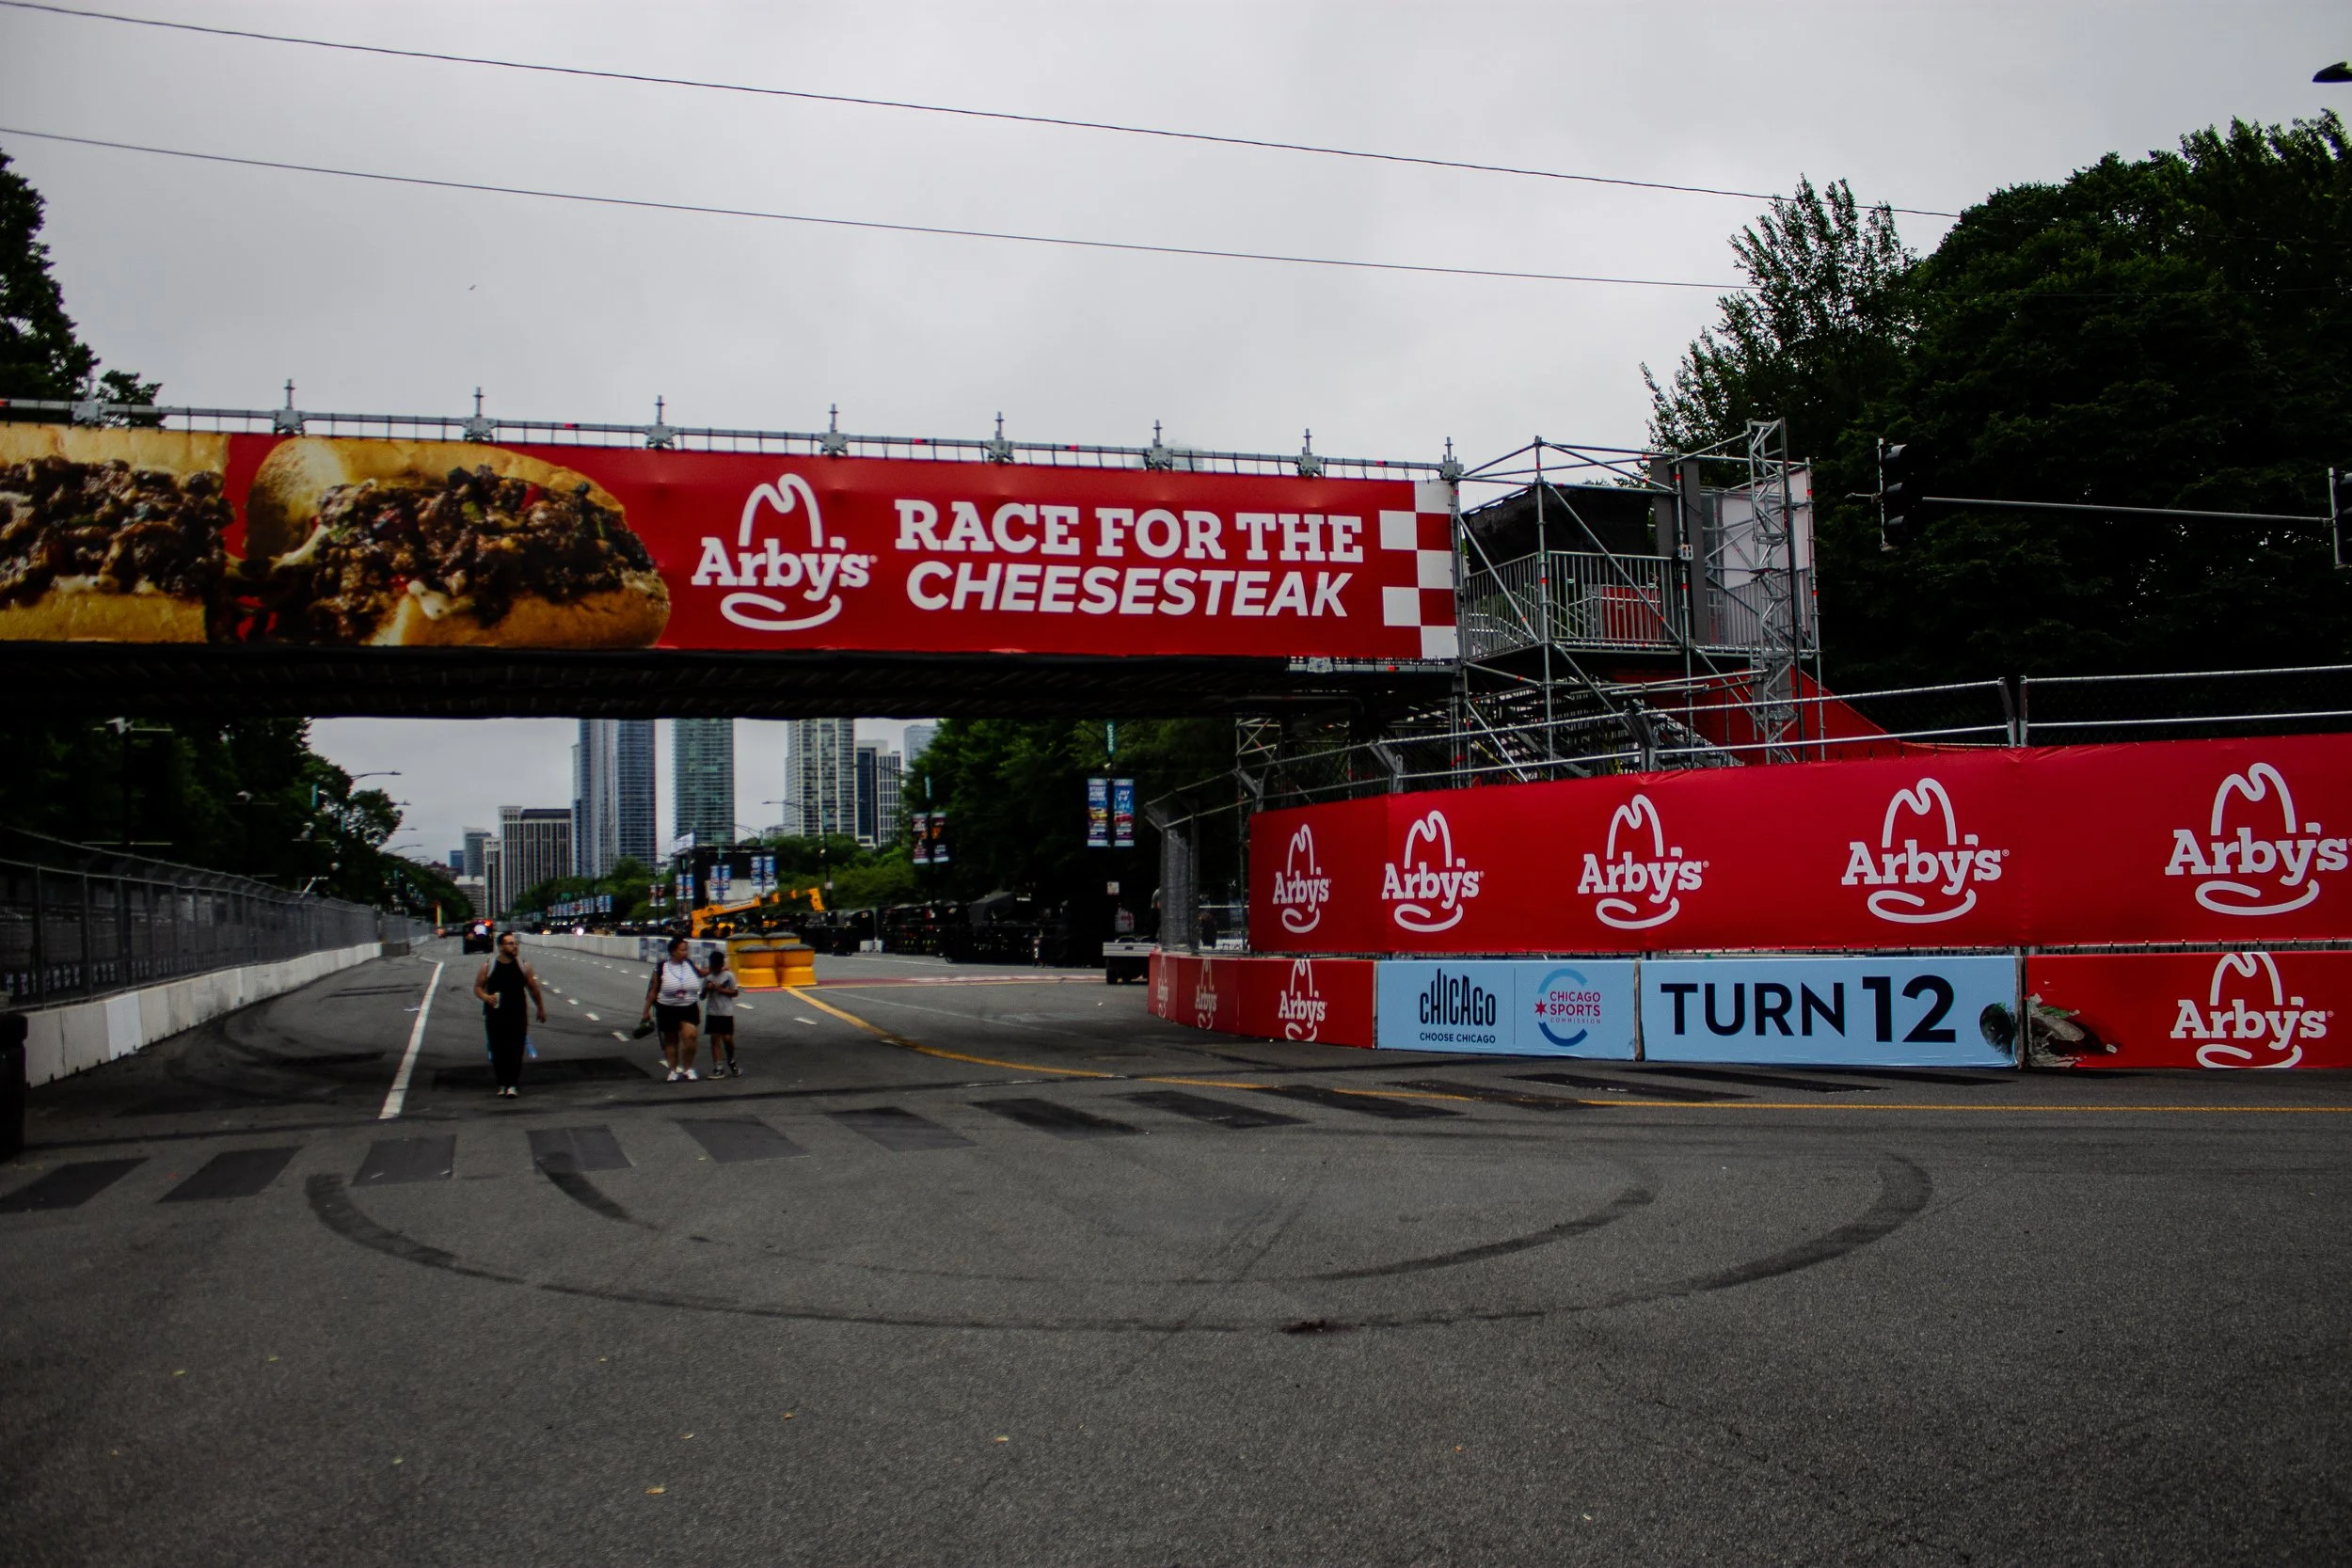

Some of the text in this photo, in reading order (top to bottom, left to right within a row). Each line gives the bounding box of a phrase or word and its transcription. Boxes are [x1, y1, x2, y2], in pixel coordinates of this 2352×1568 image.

[895, 499, 1364, 563] RACE FOR THE
[691, 536, 871, 602] Arby's
[906, 561, 1353, 617] CHEESESTEAK
[1577, 847, 1704, 904] Arby's
[1841, 833, 2003, 895] Arby's
[2165, 822, 2350, 886] Arby's
[1272, 866, 1329, 915] Arby's
[1382, 858, 1481, 909] Arby's
[1279, 990, 1326, 1029] Arby's
[1549, 991, 1602, 1003] CHICAGO
[1549, 1004, 1601, 1017] SPORTS
[1661, 974, 1956, 1043] TURN 12
[2169, 995, 2327, 1051] Arby's
[1420, 1032, 1496, 1044] CHOOSE CHICAGO
